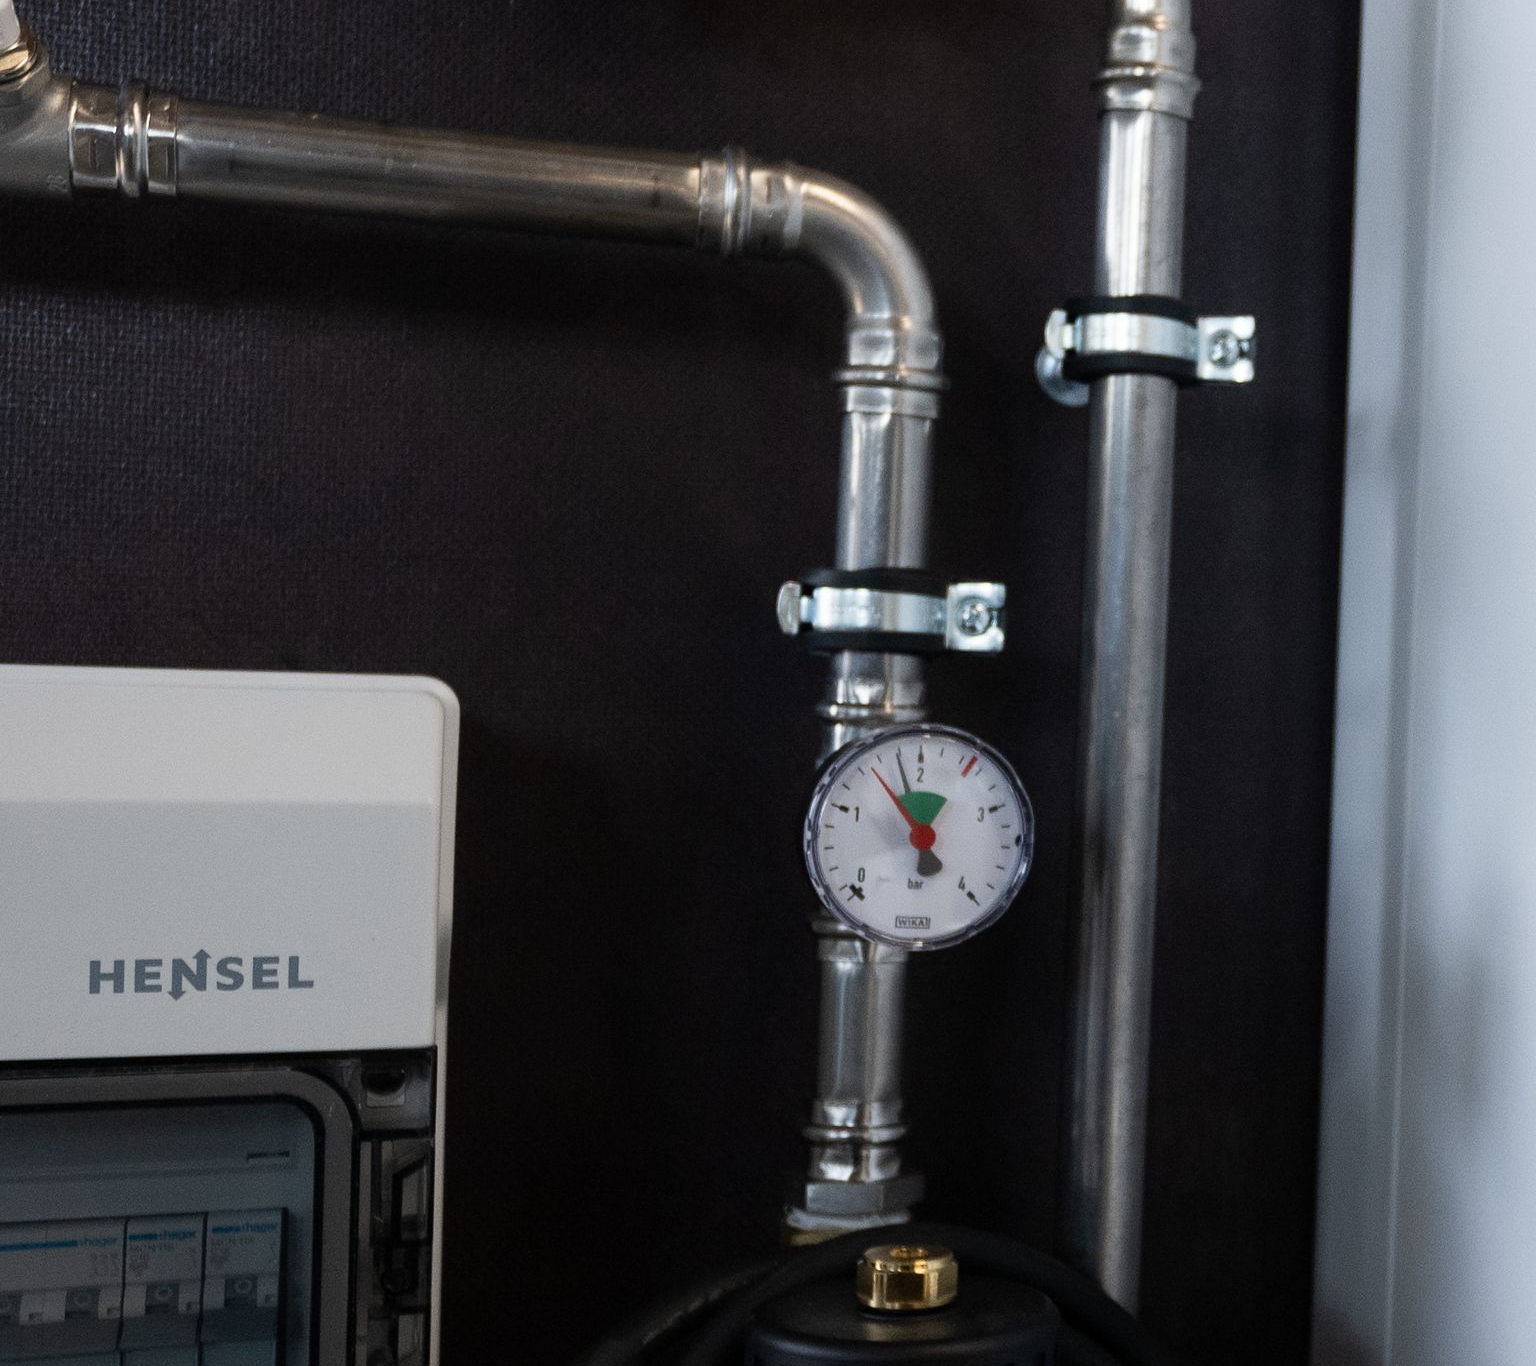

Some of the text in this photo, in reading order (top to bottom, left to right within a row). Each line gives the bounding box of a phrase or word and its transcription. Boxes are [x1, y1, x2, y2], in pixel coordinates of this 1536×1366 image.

[916, 767, 925, 783] 2
[853, 807, 861, 823] 1
[976, 807, 985, 823] 3
[856, 867, 866, 884] 0
[957, 876, 967, 891] 4
[907, 877, 924, 891] bar
[89, 949, 315, 1001] HENSEL
